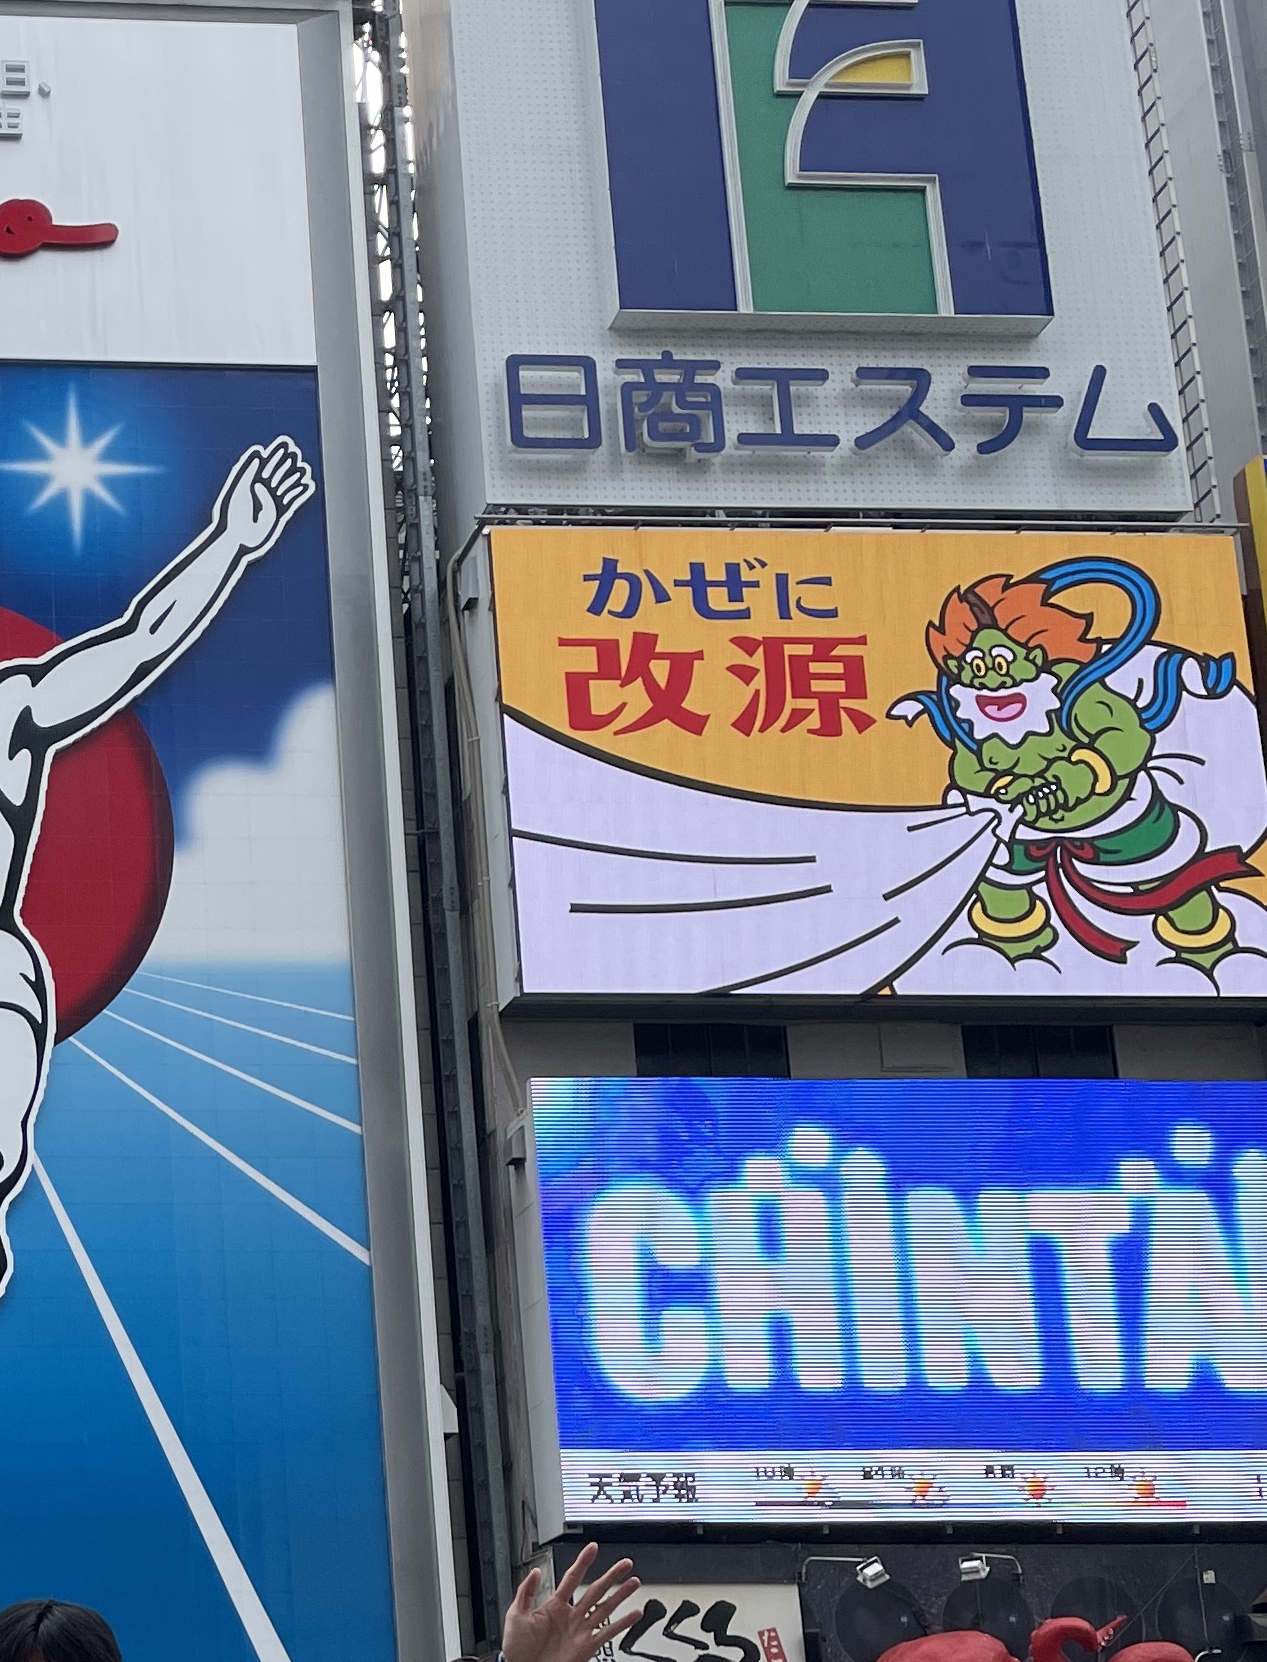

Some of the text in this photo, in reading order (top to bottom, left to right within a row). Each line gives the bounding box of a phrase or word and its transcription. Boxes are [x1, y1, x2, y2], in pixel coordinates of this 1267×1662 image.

[505, 350, 1178, 455] 日商エステム
[583, 556, 839, 622] かぜに
[557, 632, 877, 738] 改源
